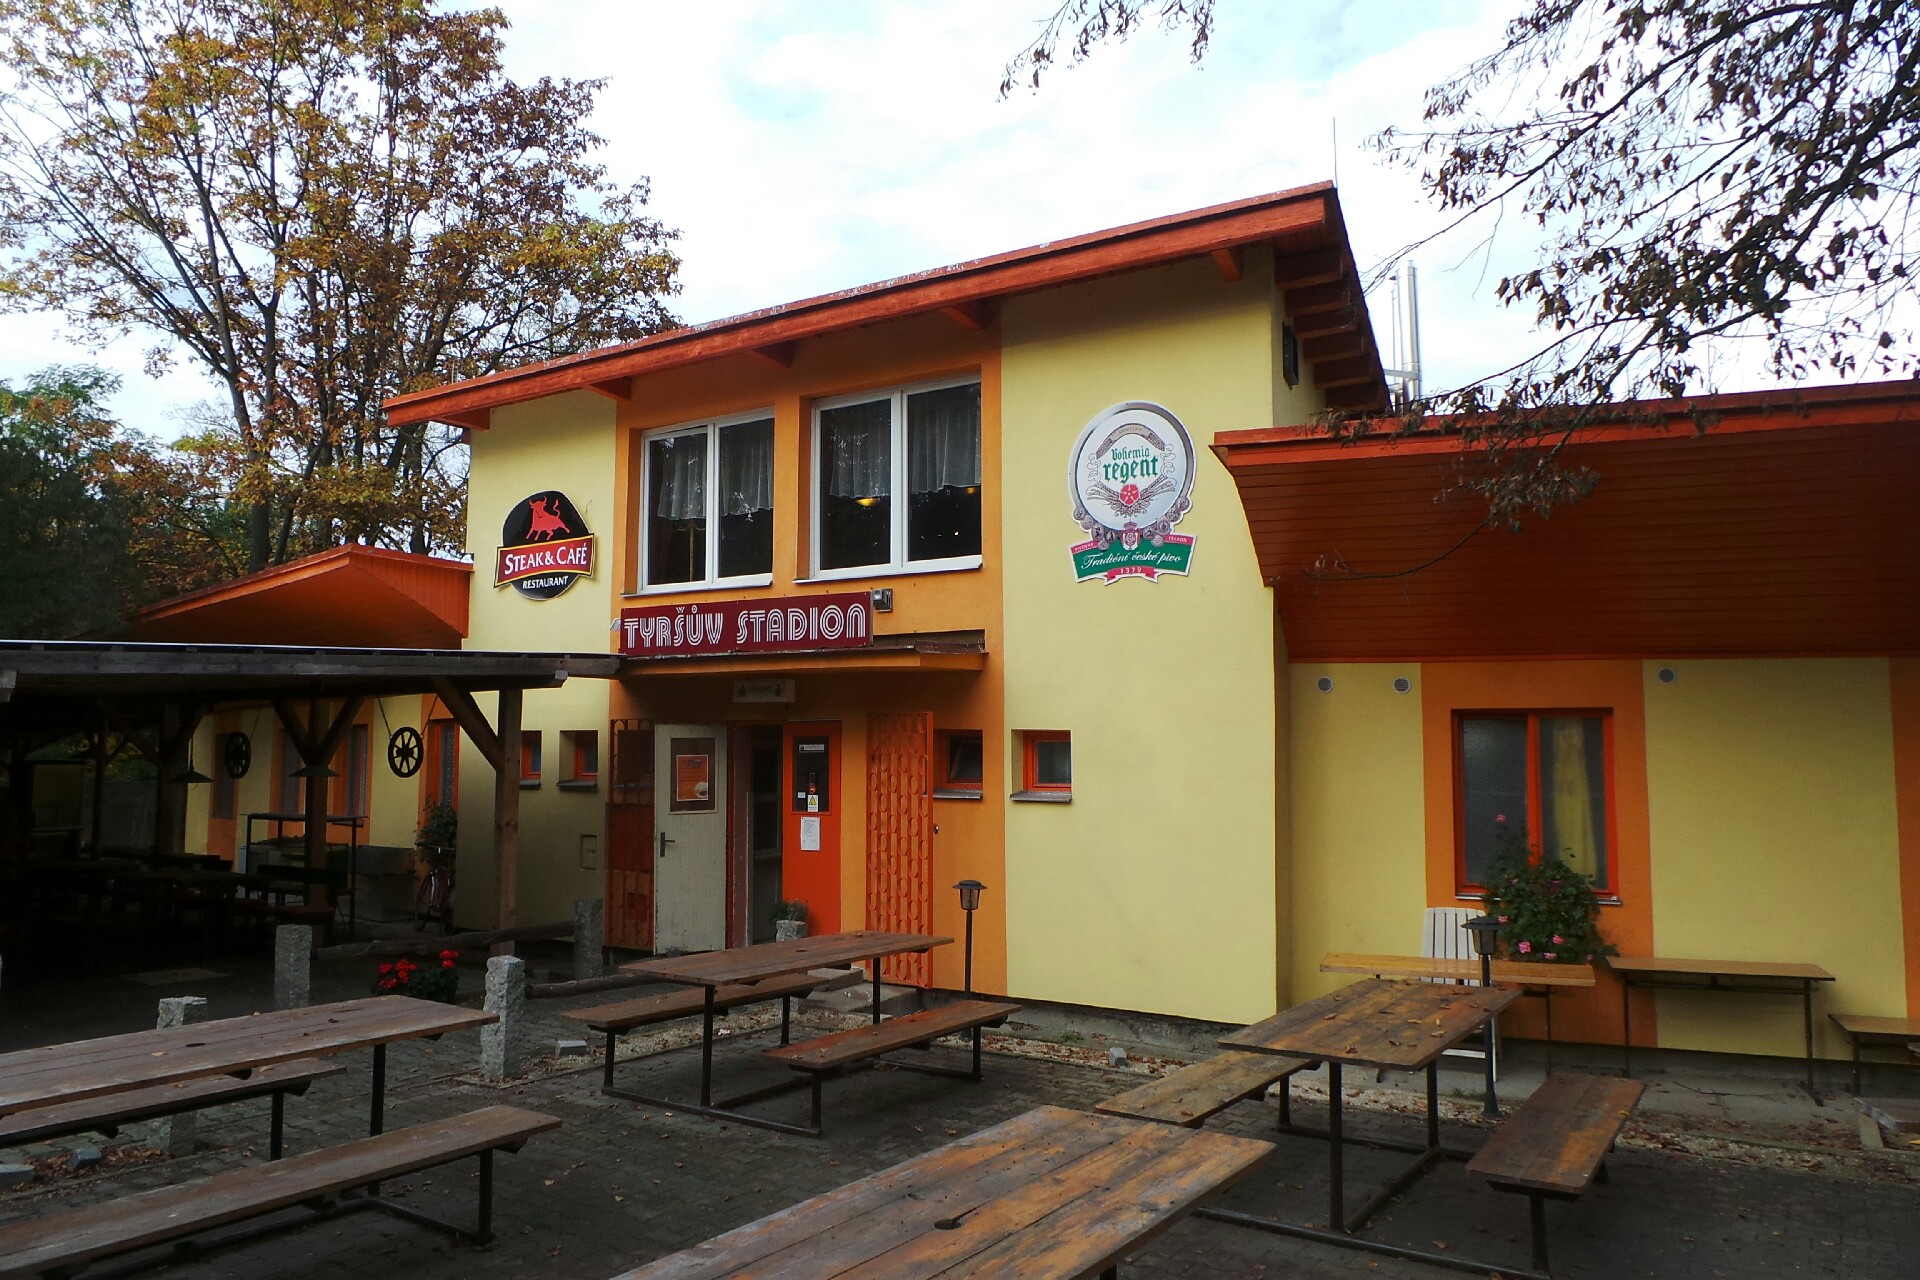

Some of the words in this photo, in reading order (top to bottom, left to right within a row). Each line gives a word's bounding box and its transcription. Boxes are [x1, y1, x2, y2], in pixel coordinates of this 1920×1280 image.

[1111, 446, 1150, 460] Bohemia
[1103, 455, 1158, 484] regent
[1081, 552, 1131, 569] Tradiční
[1131, 550, 1160, 561] české
[1156, 552, 1182, 565] pivo
[522, 576, 568, 590] RESTAURANT
[624, 604, 723, 649] TYRŠŮV
[737, 603, 866, 644] STADION
